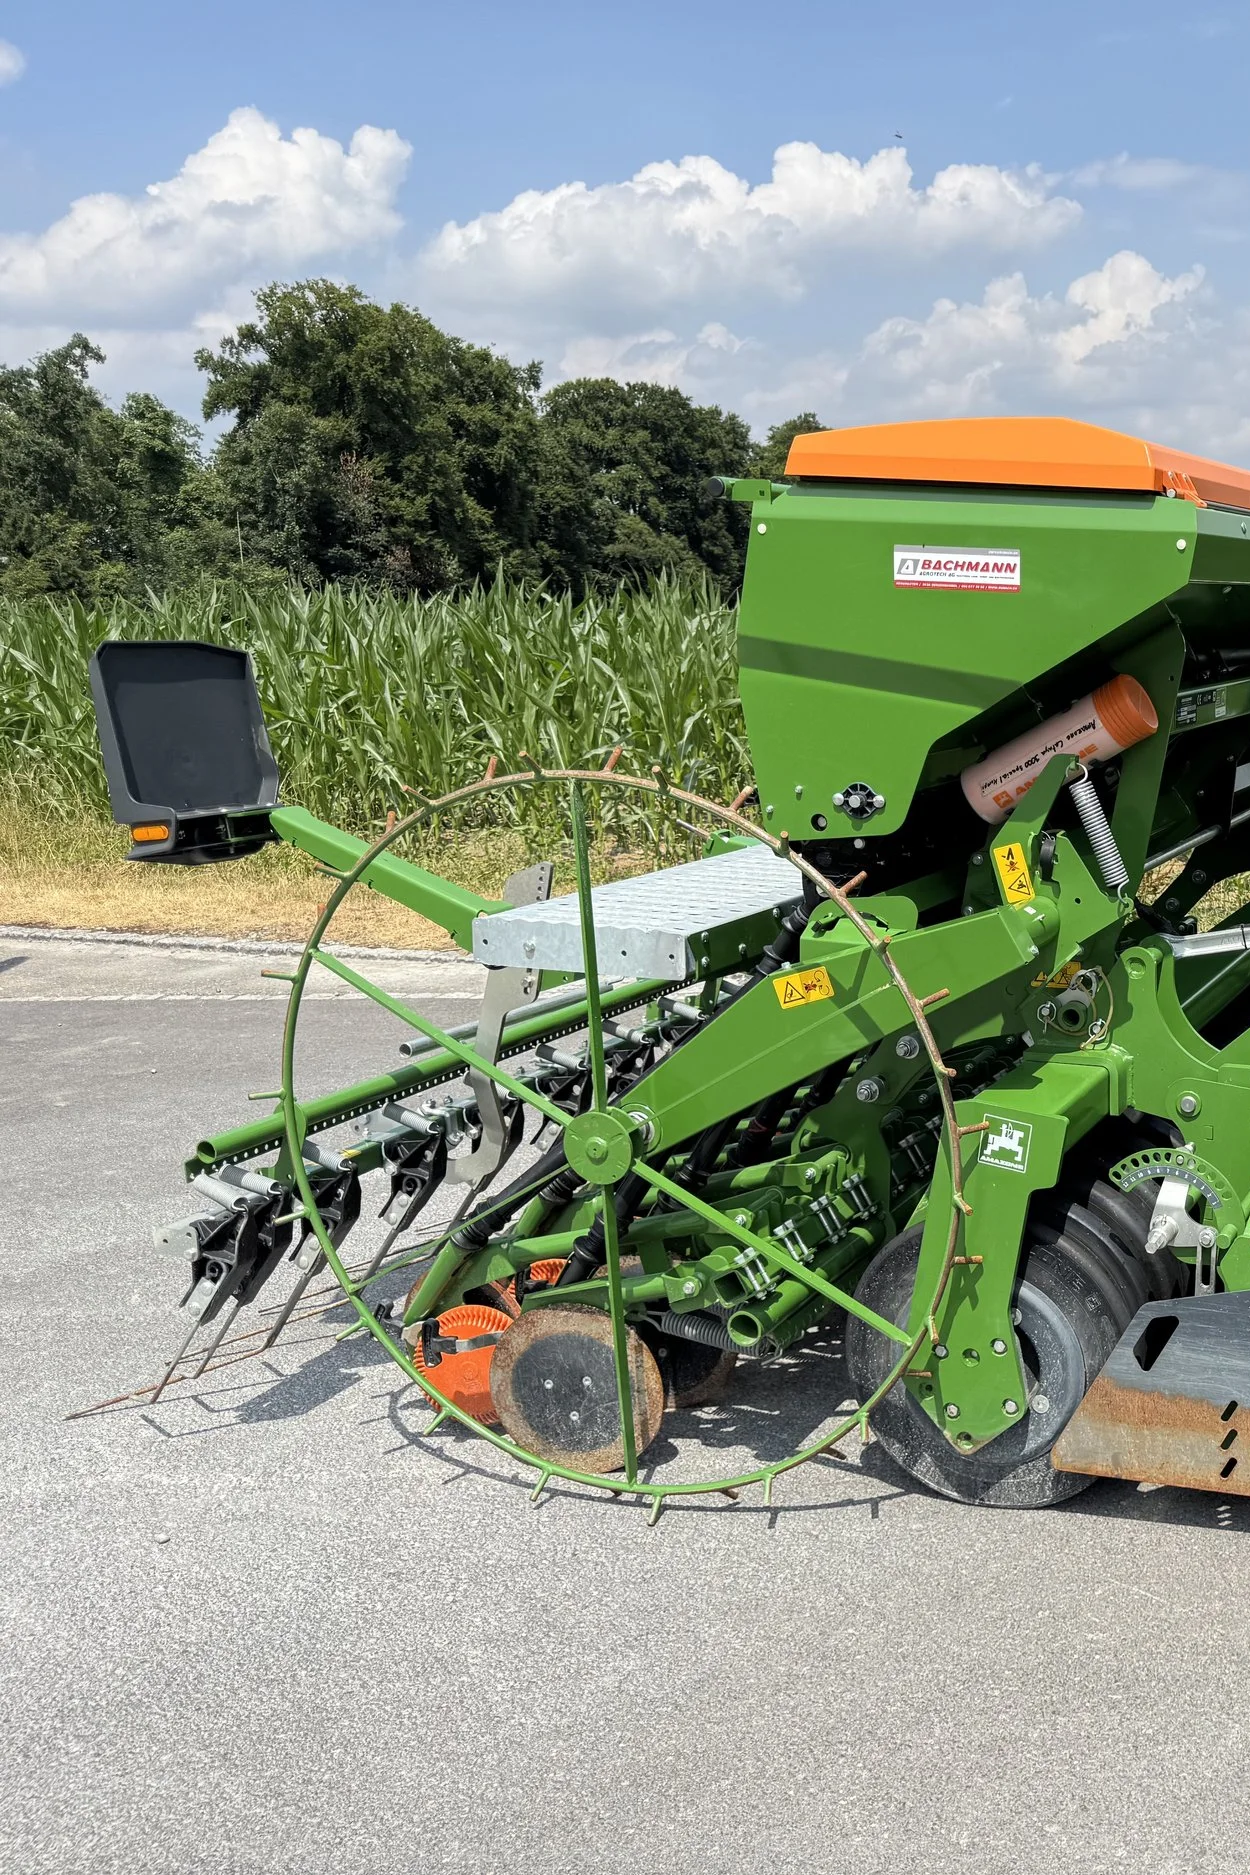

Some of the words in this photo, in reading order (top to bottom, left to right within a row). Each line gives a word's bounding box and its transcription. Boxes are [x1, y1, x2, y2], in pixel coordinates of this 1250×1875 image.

[921, 559, 1017, 574] BACHMANN
[1024, 753, 1040, 767] 3000
[980, 1155, 1024, 1171] AMAZONE
